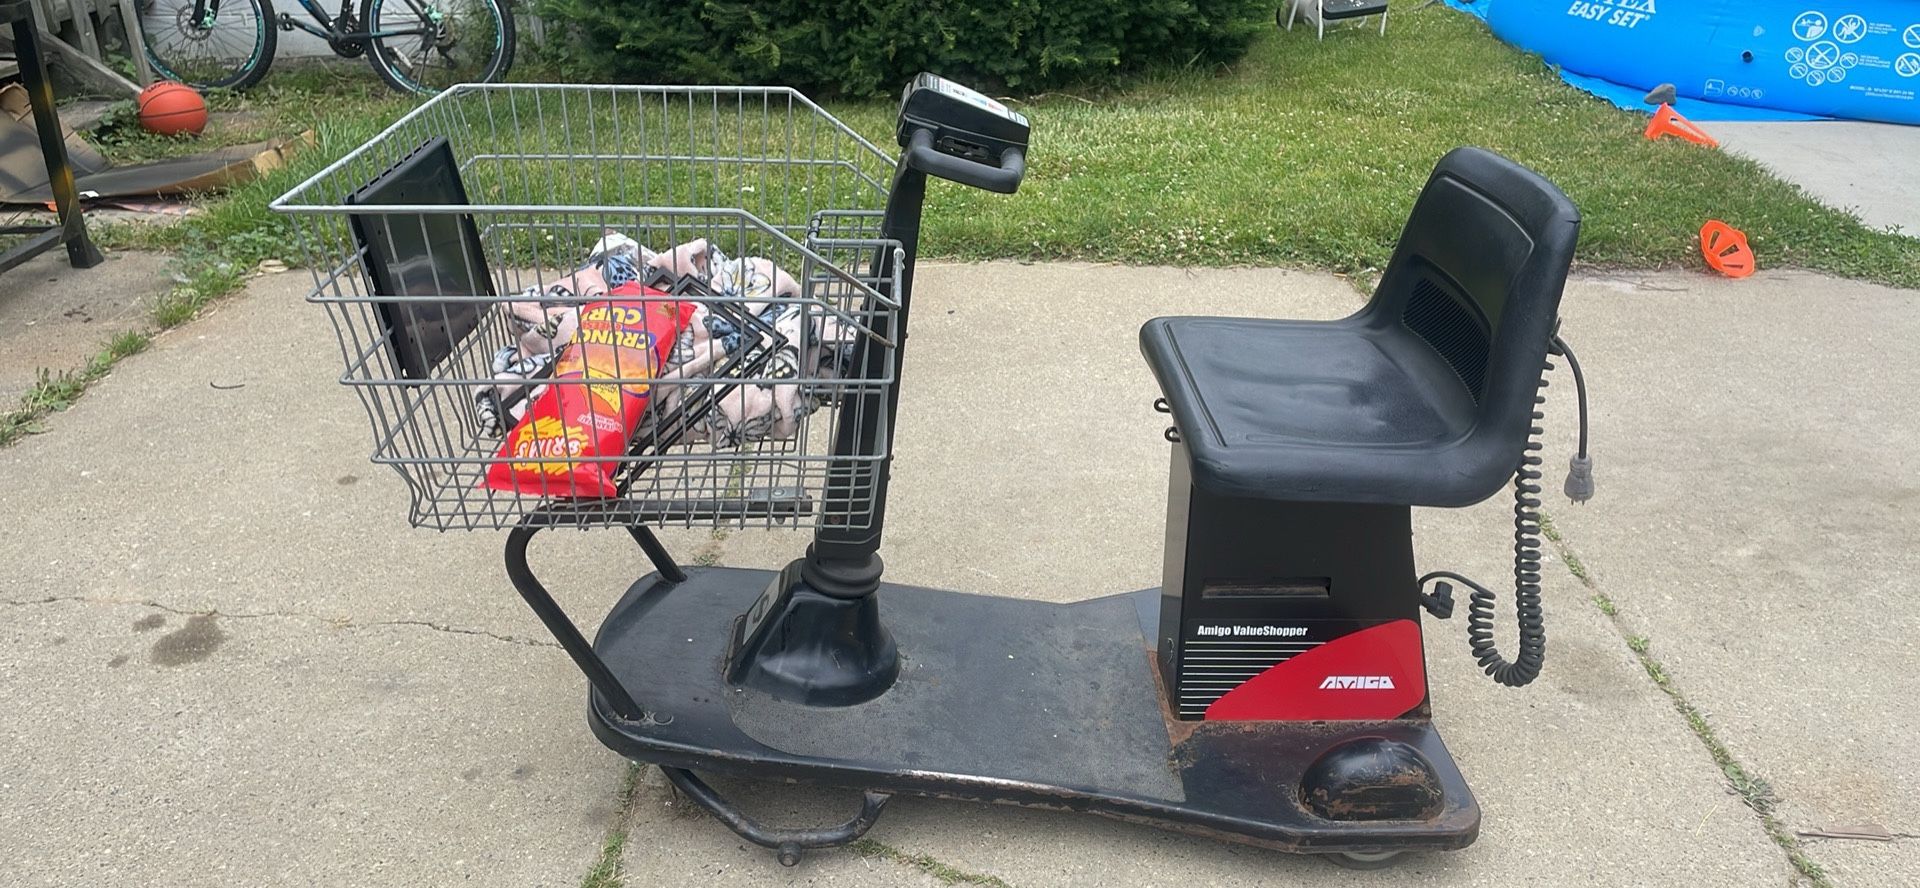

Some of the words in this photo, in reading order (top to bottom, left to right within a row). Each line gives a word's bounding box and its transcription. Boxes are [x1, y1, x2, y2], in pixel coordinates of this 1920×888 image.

[1567, 1, 1612, 21] EASY
[1608, 9, 1646, 28] SET
[581, 307, 641, 326] CUR
[1197, 625, 1231, 637] Amigo
[1233, 625, 1308, 637] ValueShopper
[1318, 675, 1396, 689] AMIGO
